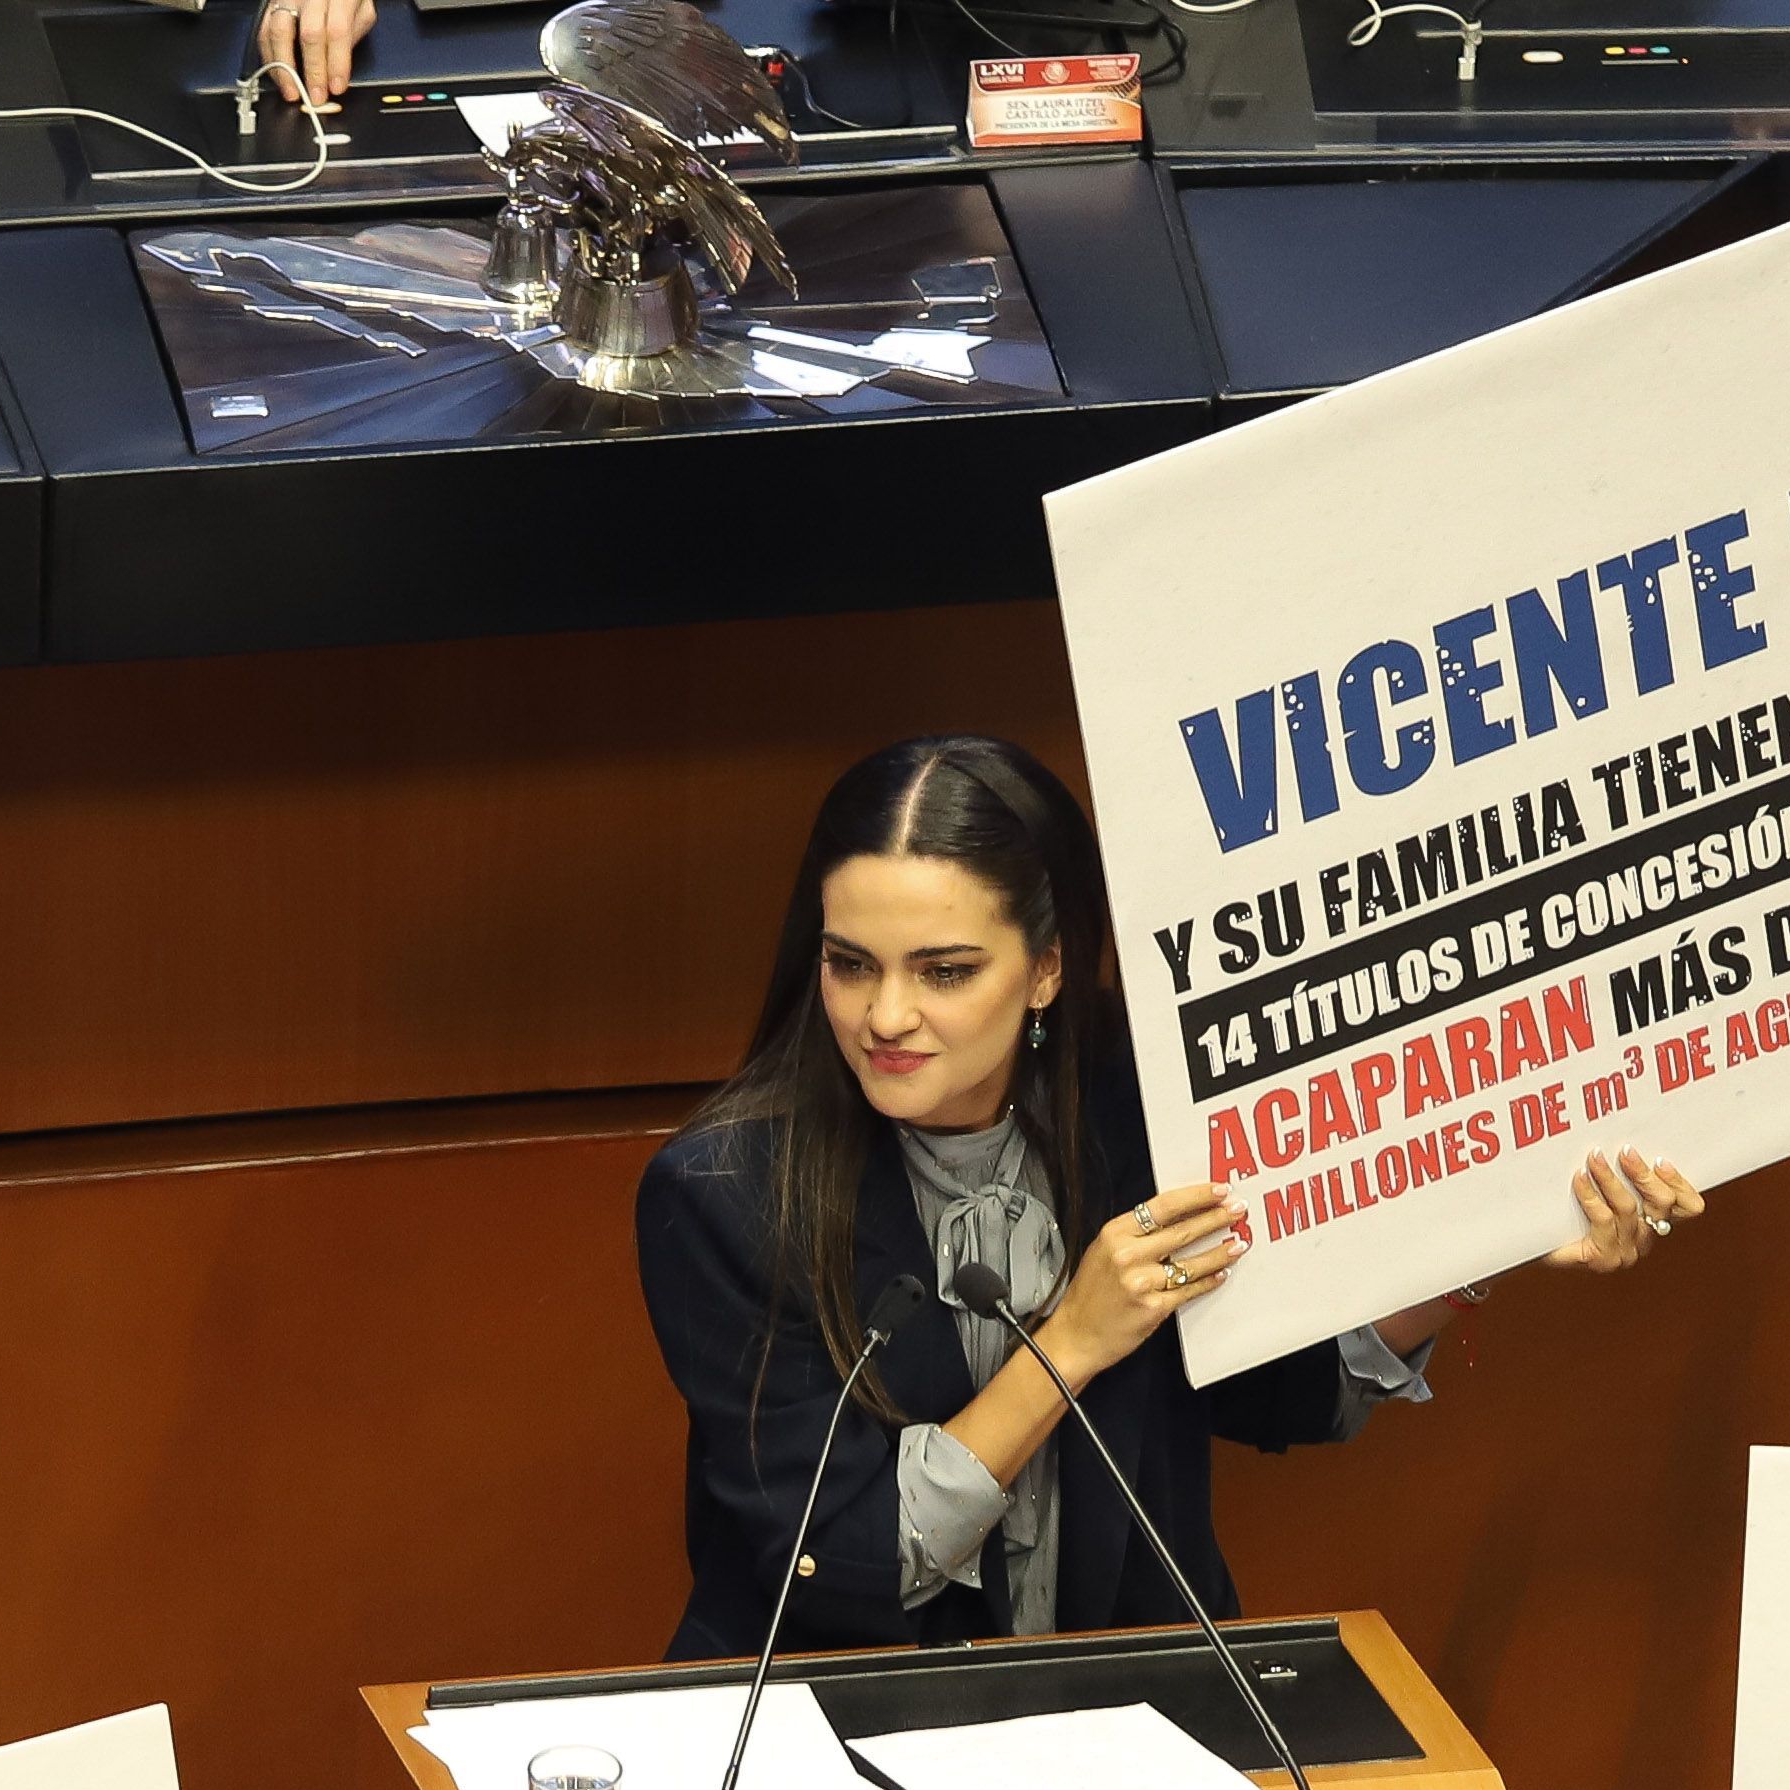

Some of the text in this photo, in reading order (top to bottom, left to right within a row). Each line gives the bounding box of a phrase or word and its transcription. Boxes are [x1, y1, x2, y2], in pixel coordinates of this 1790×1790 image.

[980, 63, 1024, 76] LXVI
[1177, 507, 1769, 855] VICENTE
[1152, 918, 1194, 996] Y
[1212, 880, 1306, 975] SU
[1318, 777, 1587, 939] FAMILIA
[1197, 1012, 1258, 1078] 14
[1261, 936, 1464, 1054] TÍTULOS
[1470, 907, 1535, 979] DE
[1207, 974, 1596, 1185] ACAPARAN
[1608, 925, 1753, 1038] MÁS
[1262, 1110, 1501, 1244] MILLONES
[1508, 1080, 1572, 1151] DE
[1653, 1024, 1716, 1095] DE
